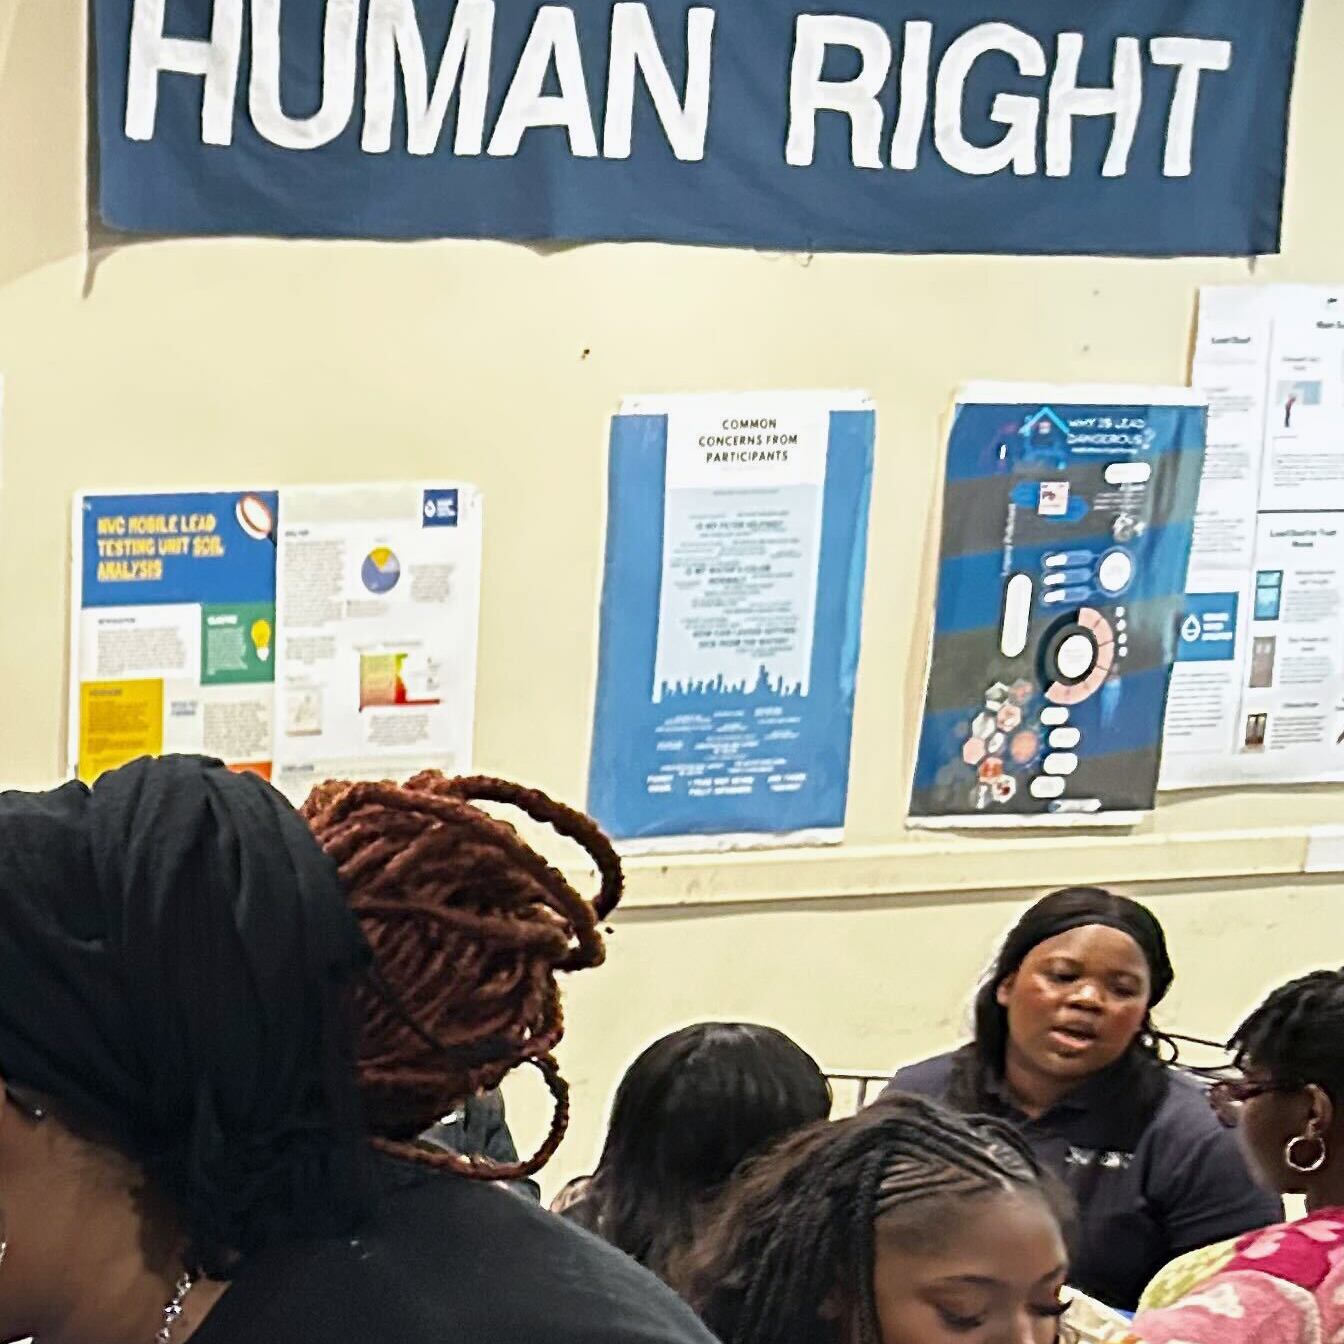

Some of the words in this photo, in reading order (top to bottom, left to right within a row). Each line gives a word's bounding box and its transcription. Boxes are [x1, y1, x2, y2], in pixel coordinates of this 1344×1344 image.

[124, 0, 714, 161] HUMAN
[785, 13, 1232, 178] RIGHT
[722, 418, 777, 431] COMMON
[698, 434, 762, 448] CONCERNS
[765, 434, 798, 446] FROM
[706, 450, 789, 464] PARTICIPANTS
[128, 514, 179, 535] MOBILE
[180, 512, 217, 533] LEAD
[97, 537, 156, 557] TESTING
[158, 536, 190, 555] UNIT
[192, 535, 225, 557] SOIL
[97, 558, 163, 582] ANALYSIS
